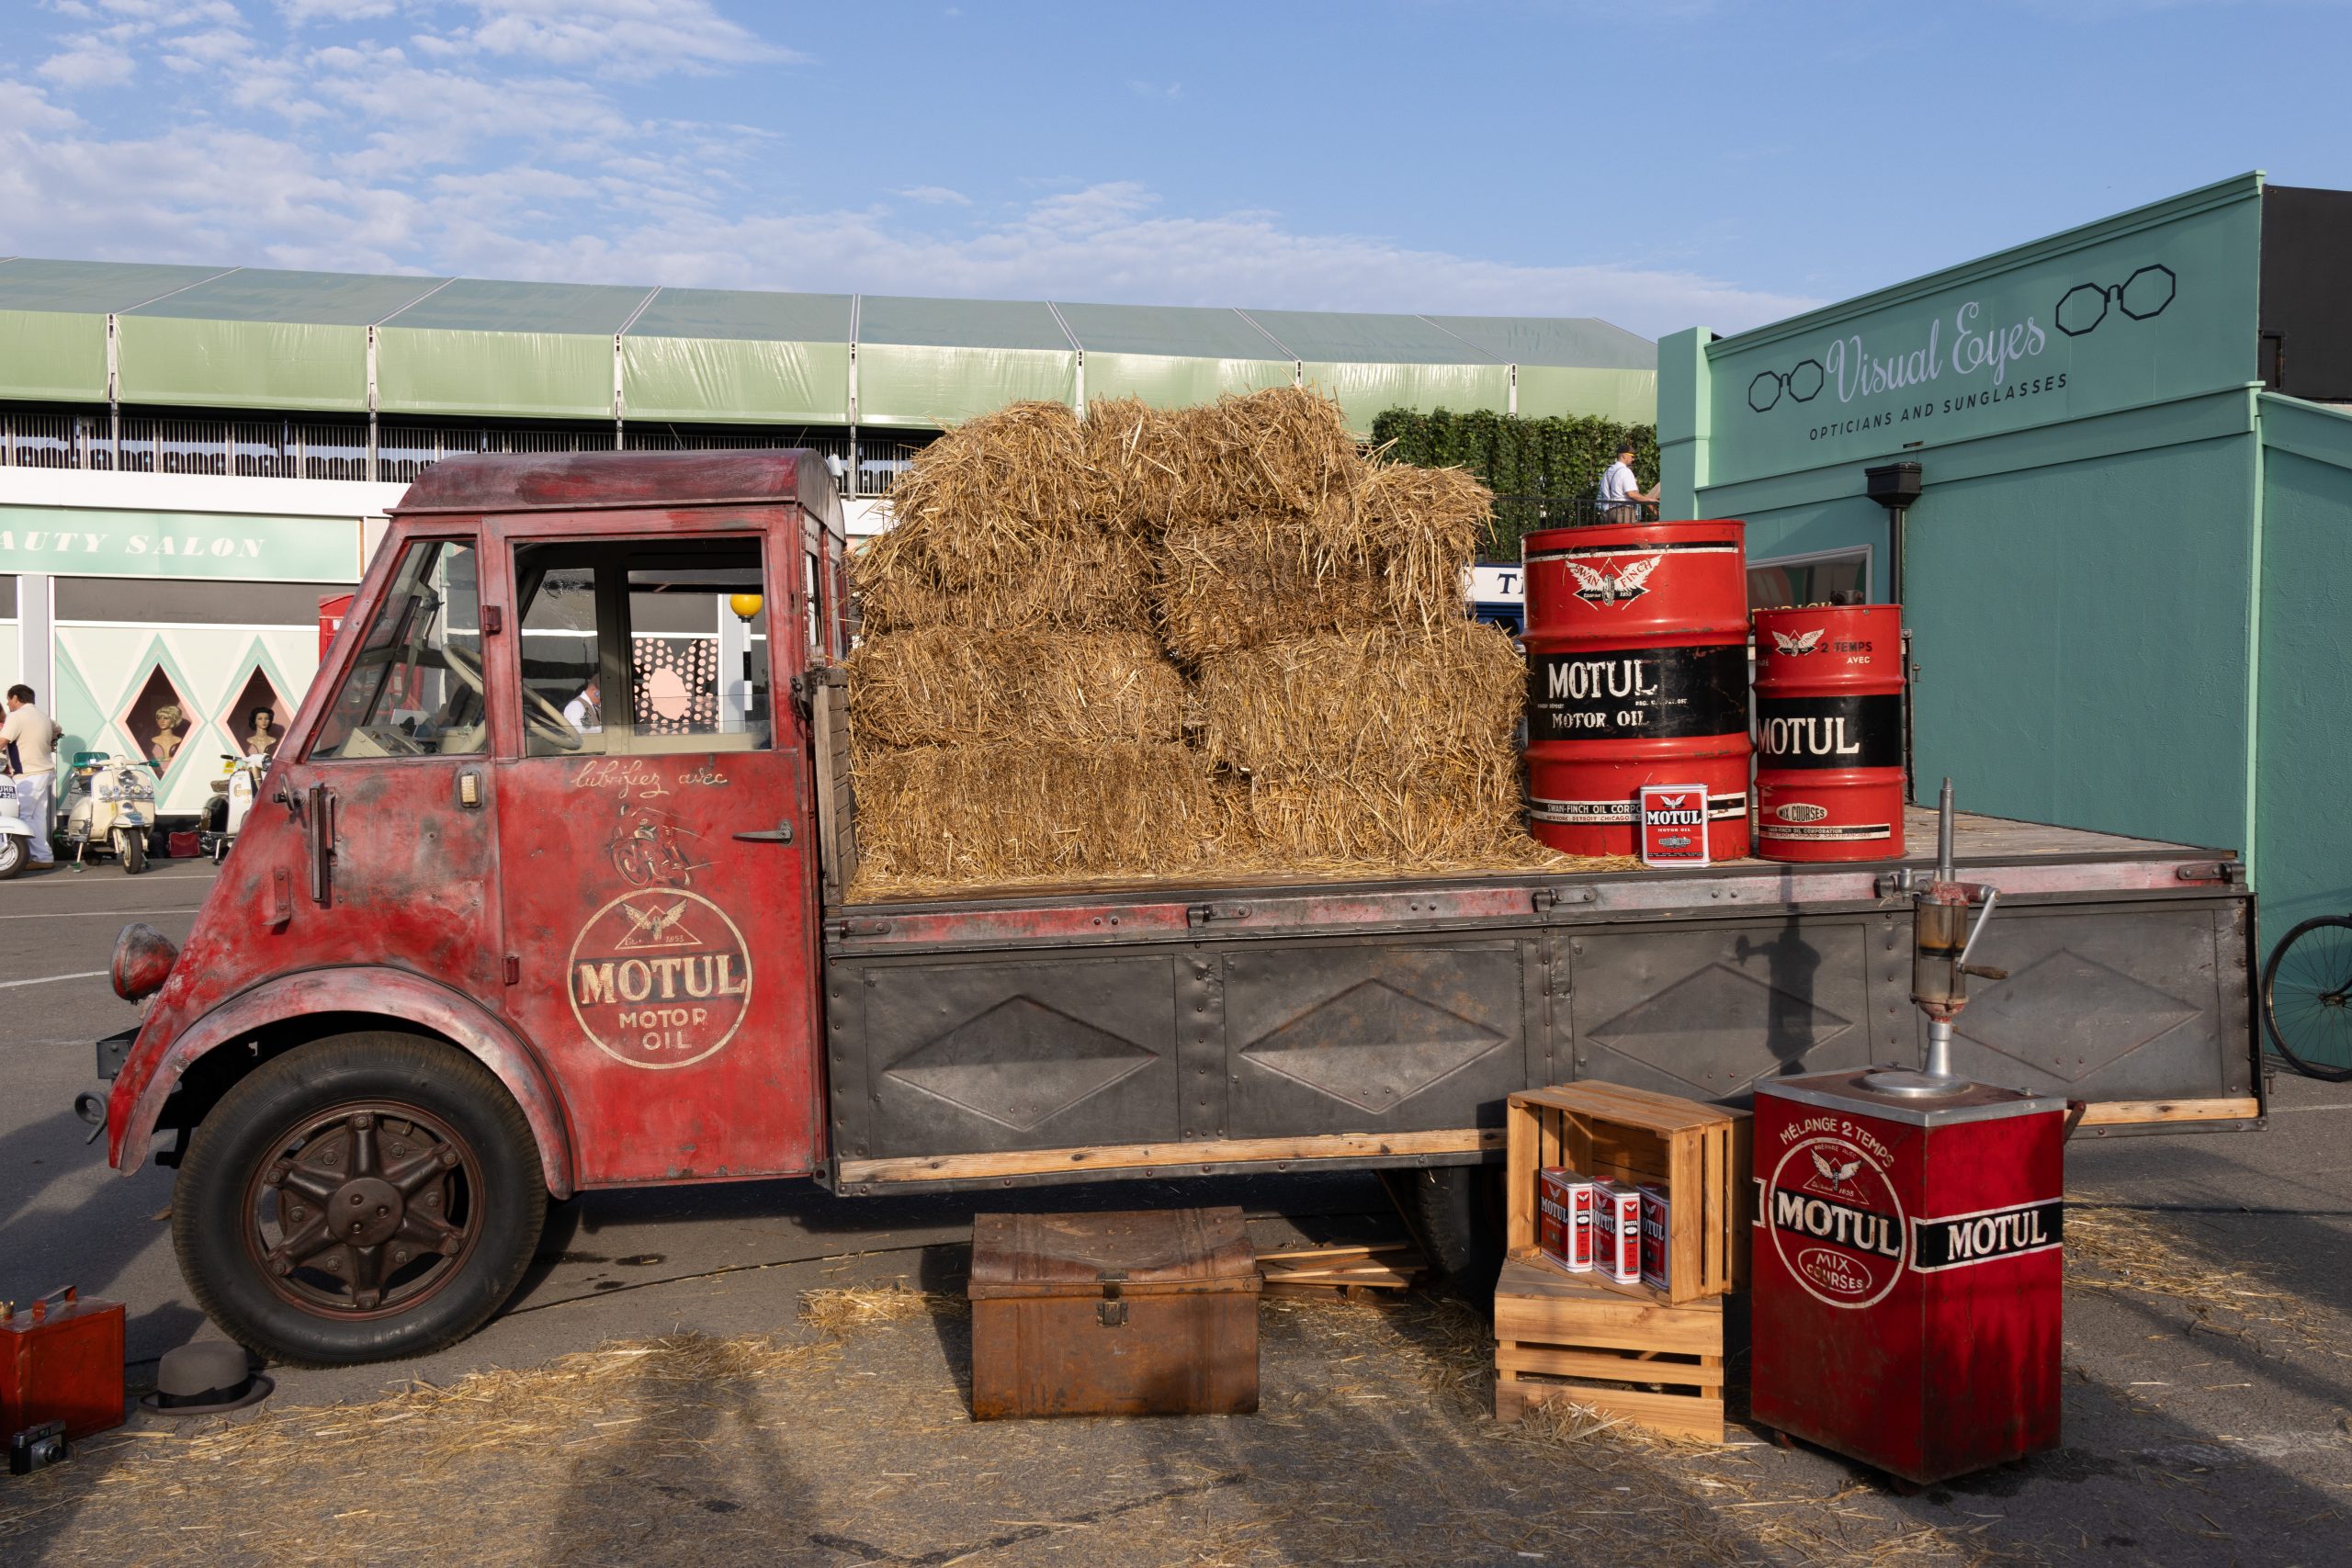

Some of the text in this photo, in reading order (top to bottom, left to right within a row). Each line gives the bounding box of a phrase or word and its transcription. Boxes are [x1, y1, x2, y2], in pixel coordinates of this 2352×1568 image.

[1826, 301, 2045, 403] Visual Eyes
[1809, 373, 2066, 441] OPTICIANS AND SUNGLASSES
[125, 535, 266, 558] SALON
[1574, 559, 1653, 588] SWAN FINCH
[1820, 641, 1872, 653] 2 TEMPS
[1846, 656, 1871, 664] AVEC
[1548, 659, 1658, 699] MOTUL
[1552, 710, 1650, 728] MOTOR OIL
[1757, 716, 1860, 755] MOTUL
[1547, 804, 1589, 814] SWAN-FINCH
[1592, 805, 1607, 814] OIL
[1646, 810, 1702, 825] MOTUL
[1778, 806, 1825, 822] MIX COURSES
[580, 955, 747, 1004] MOTUL
[618, 1008, 707, 1029] MOTOR
[642, 1031, 693, 1051] OIL
[1780, 1116, 1838, 1145] MÉLANGE
[1841, 1121, 1853, 1138] 2
[1855, 1125, 1895, 1168] TEMPS
[1541, 1196, 1568, 1224] MOTUL
[1643, 1216, 1665, 1242] OTUL
[1777, 1190, 1901, 1258] MOTUL
[1947, 1210, 2048, 1261] MOTUL
[1815, 1252, 1852, 1274] MIX
[1806, 1263, 1863, 1290] COURSES
